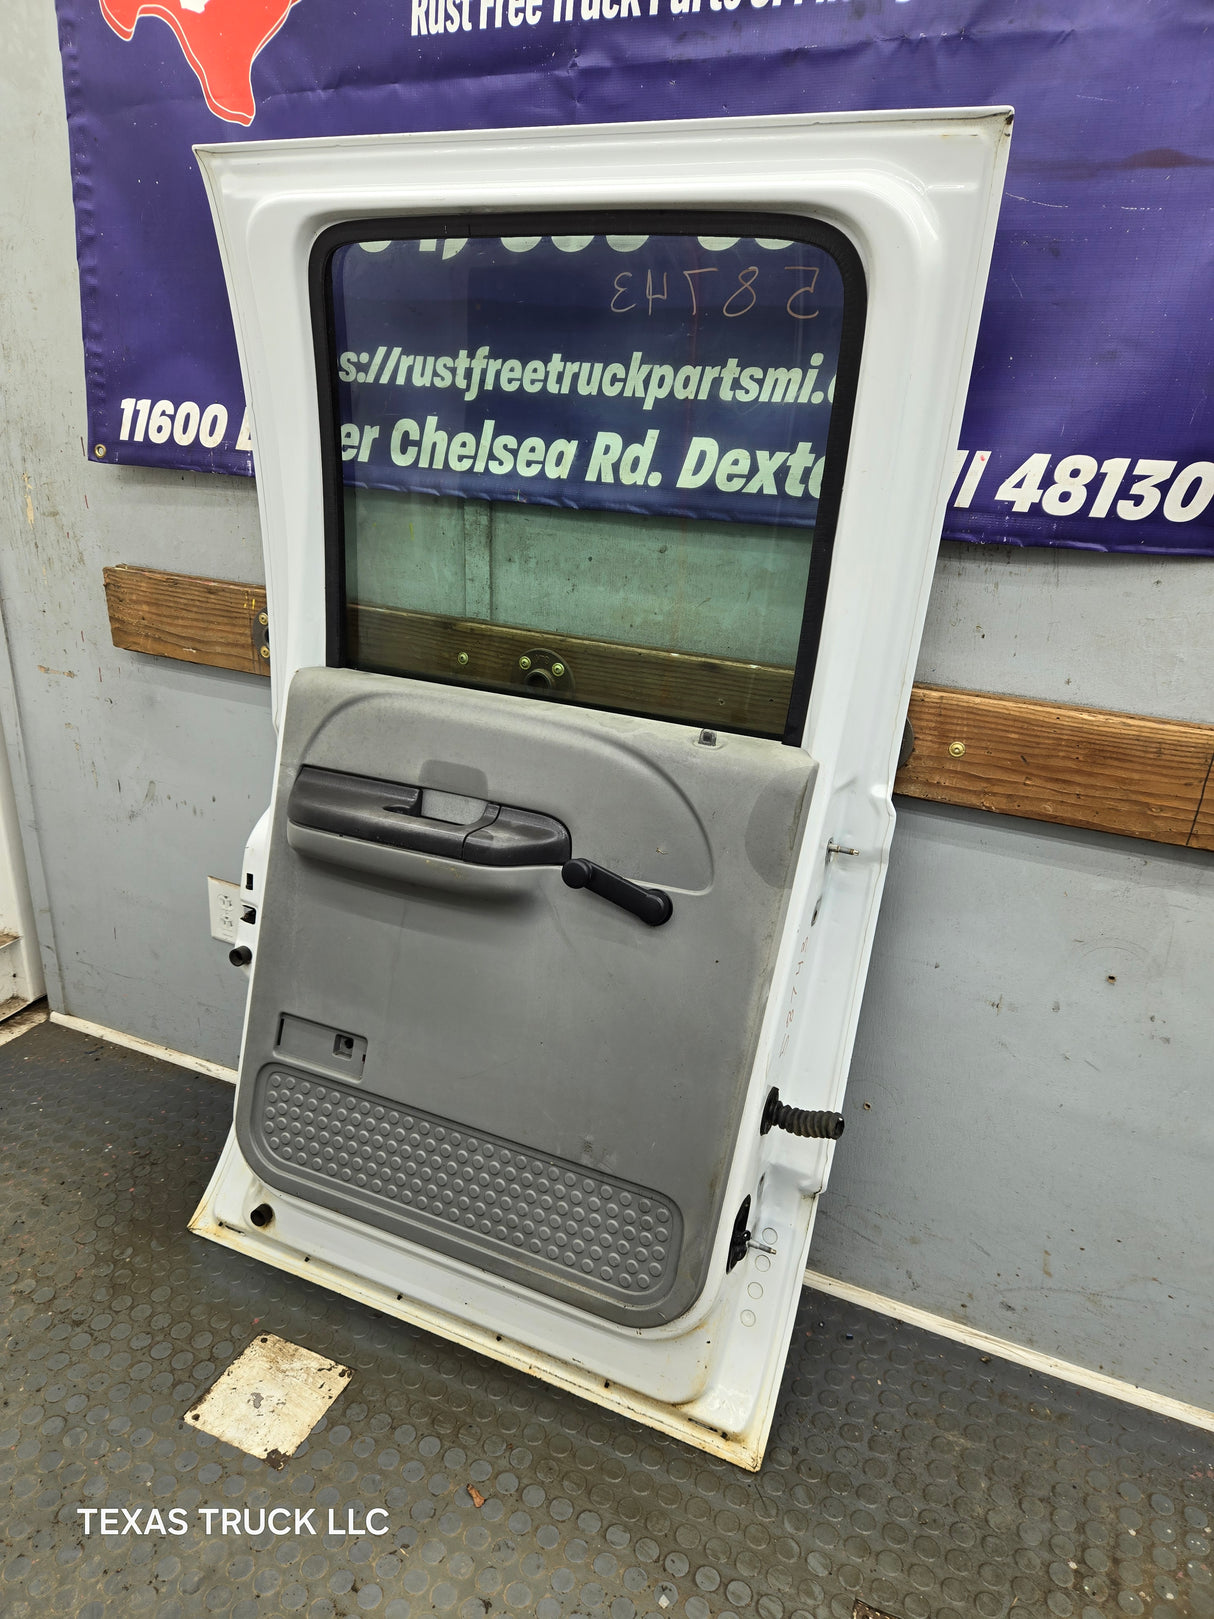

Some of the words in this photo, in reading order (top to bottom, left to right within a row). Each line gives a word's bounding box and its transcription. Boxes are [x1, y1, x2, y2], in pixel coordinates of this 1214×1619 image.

[411, 0, 472, 36] Rust
[339, 346, 836, 410] s://rustfreetruckpartsmi.
[119, 398, 228, 448] 11600
[390, 416, 578, 479] Chelsea
[585, 429, 662, 487] Rd.
[995, 453, 1214, 522] 48130
